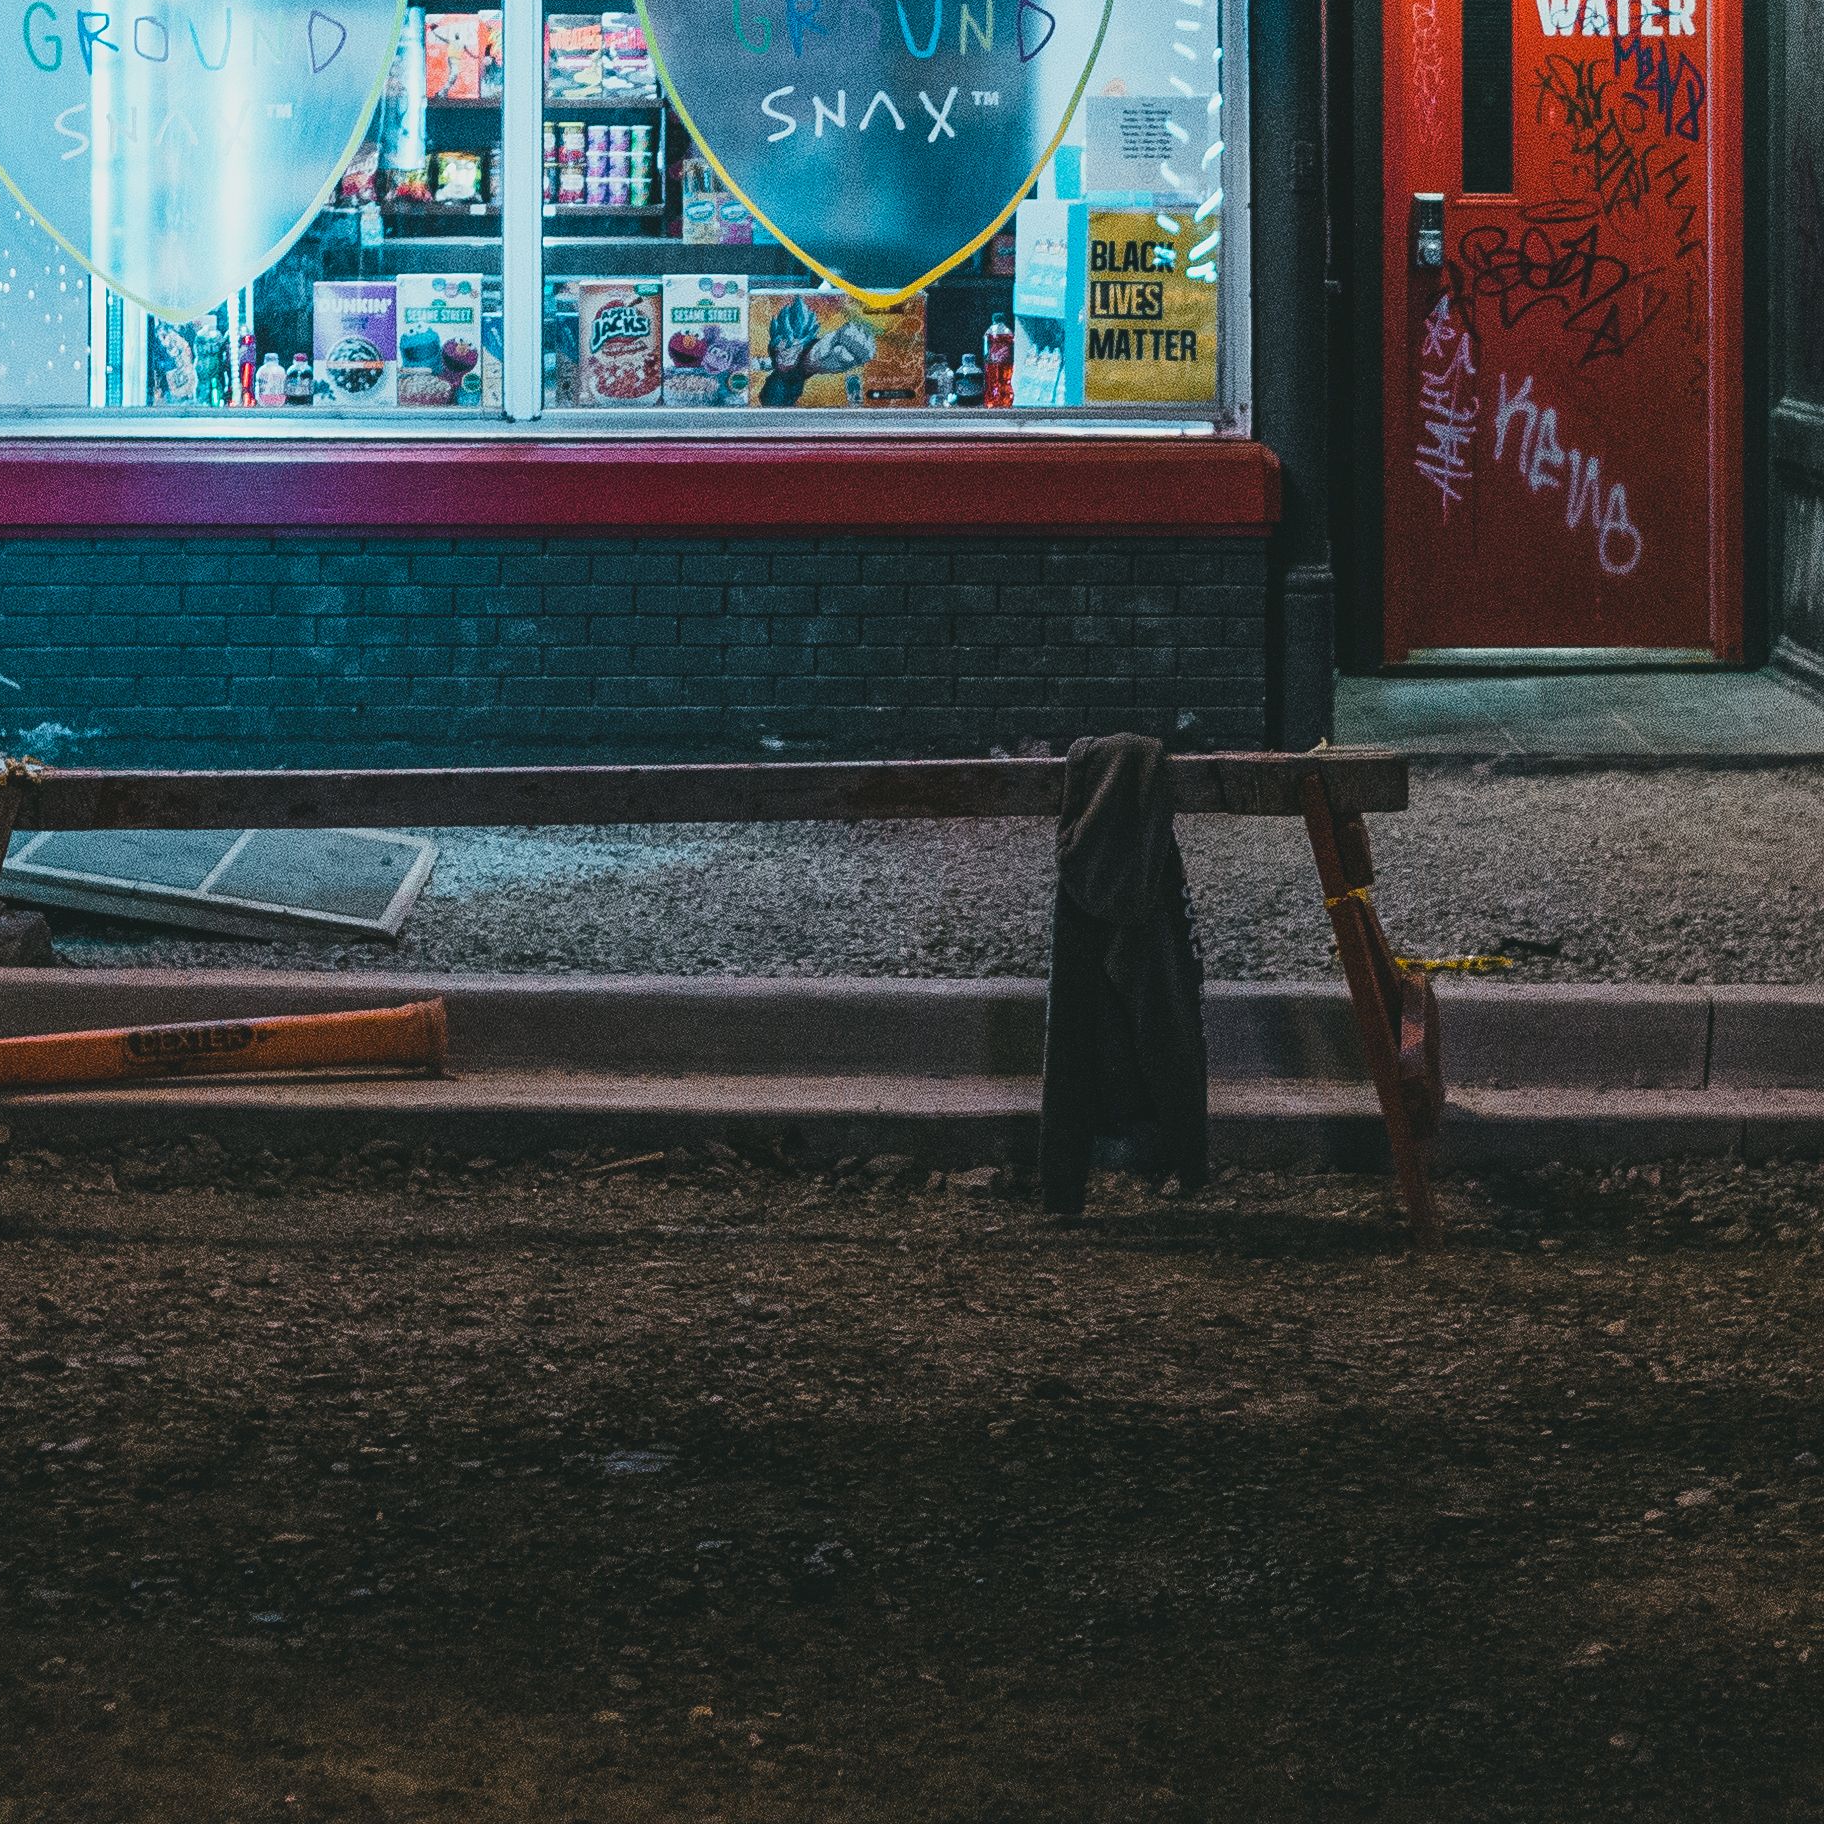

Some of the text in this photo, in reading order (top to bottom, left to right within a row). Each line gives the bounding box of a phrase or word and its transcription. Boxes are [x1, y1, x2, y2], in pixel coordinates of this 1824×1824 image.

[22, 0, 348, 76] GROUND
[1090, 239, 1175, 273] BLACK
[406, 308, 472, 323] SESAME STREET
[672, 307, 739, 322] SESAME STREET
[1094, 282, 1161, 316] LIVES
[591, 316, 649, 349] JACKS
[1088, 327, 1197, 361] MATTER
